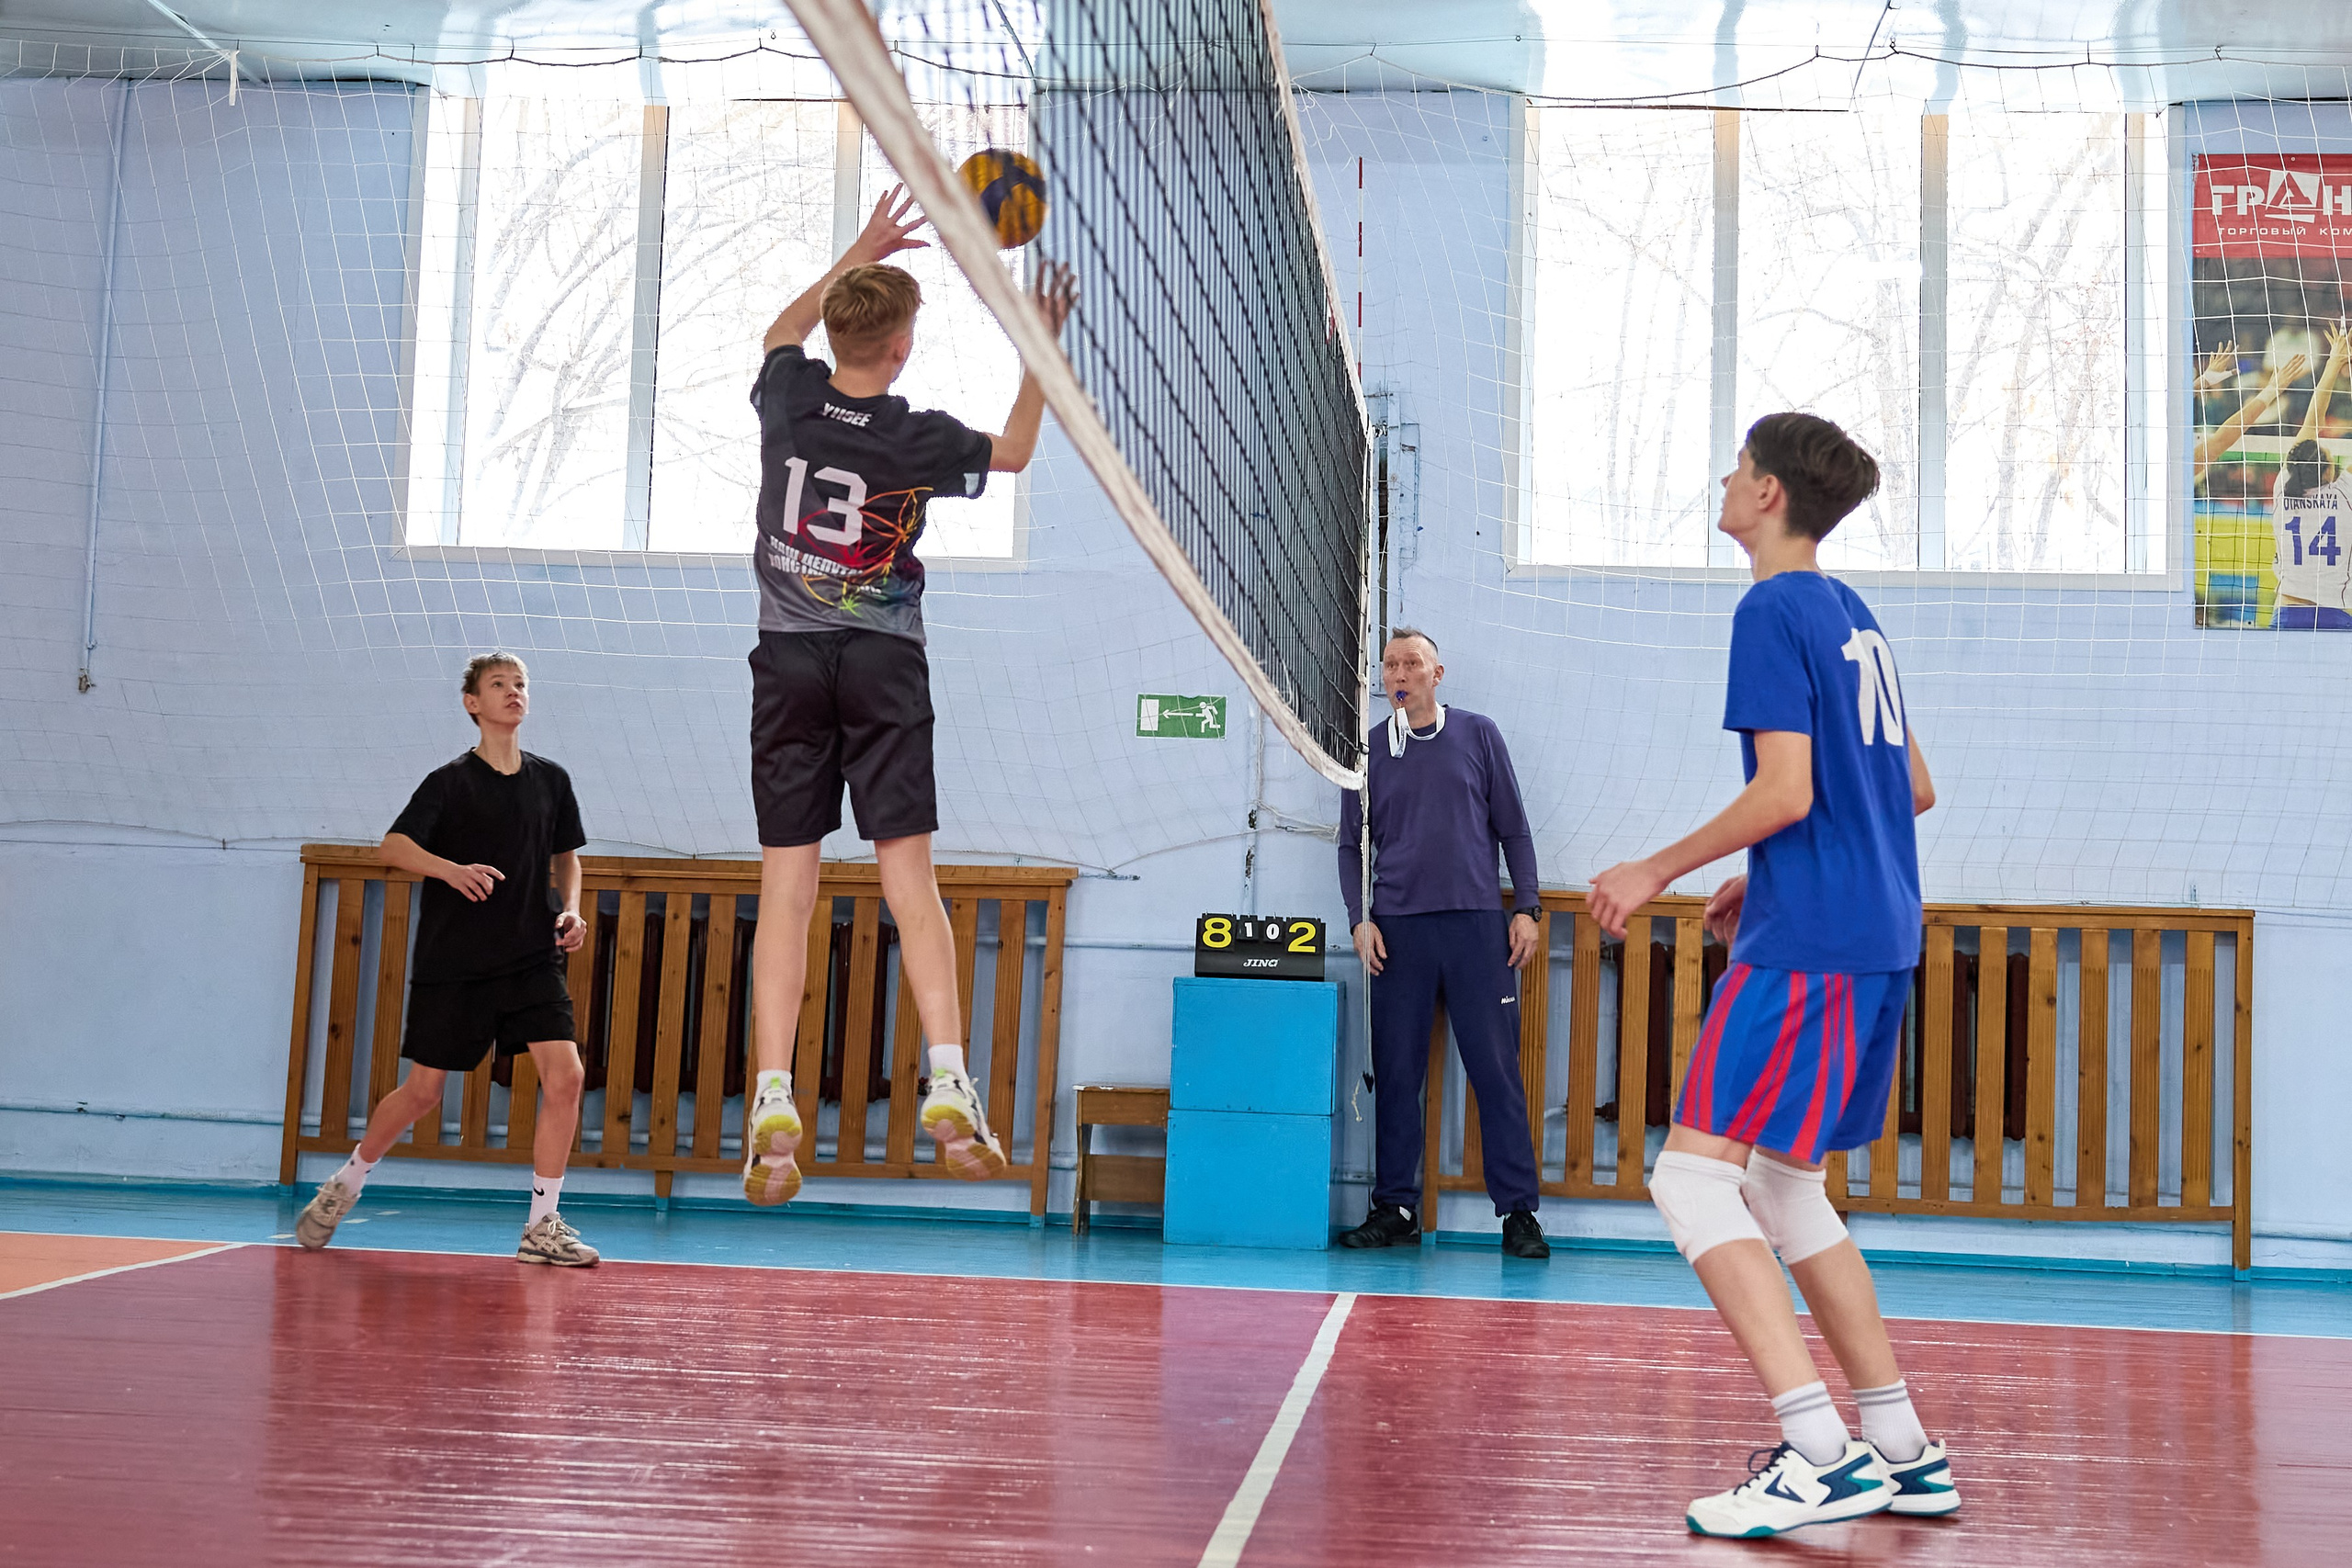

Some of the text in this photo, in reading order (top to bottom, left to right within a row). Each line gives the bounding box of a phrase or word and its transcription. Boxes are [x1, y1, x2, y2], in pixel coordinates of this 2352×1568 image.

[2218, 226, 2306, 236] ТОРГОВЫЙ
[783, 457, 868, 547] 13
[2286, 516, 2341, 565] 14
[1840, 626, 1905, 747] 10
[1202, 917, 1317, 953] 8 1 0 2
